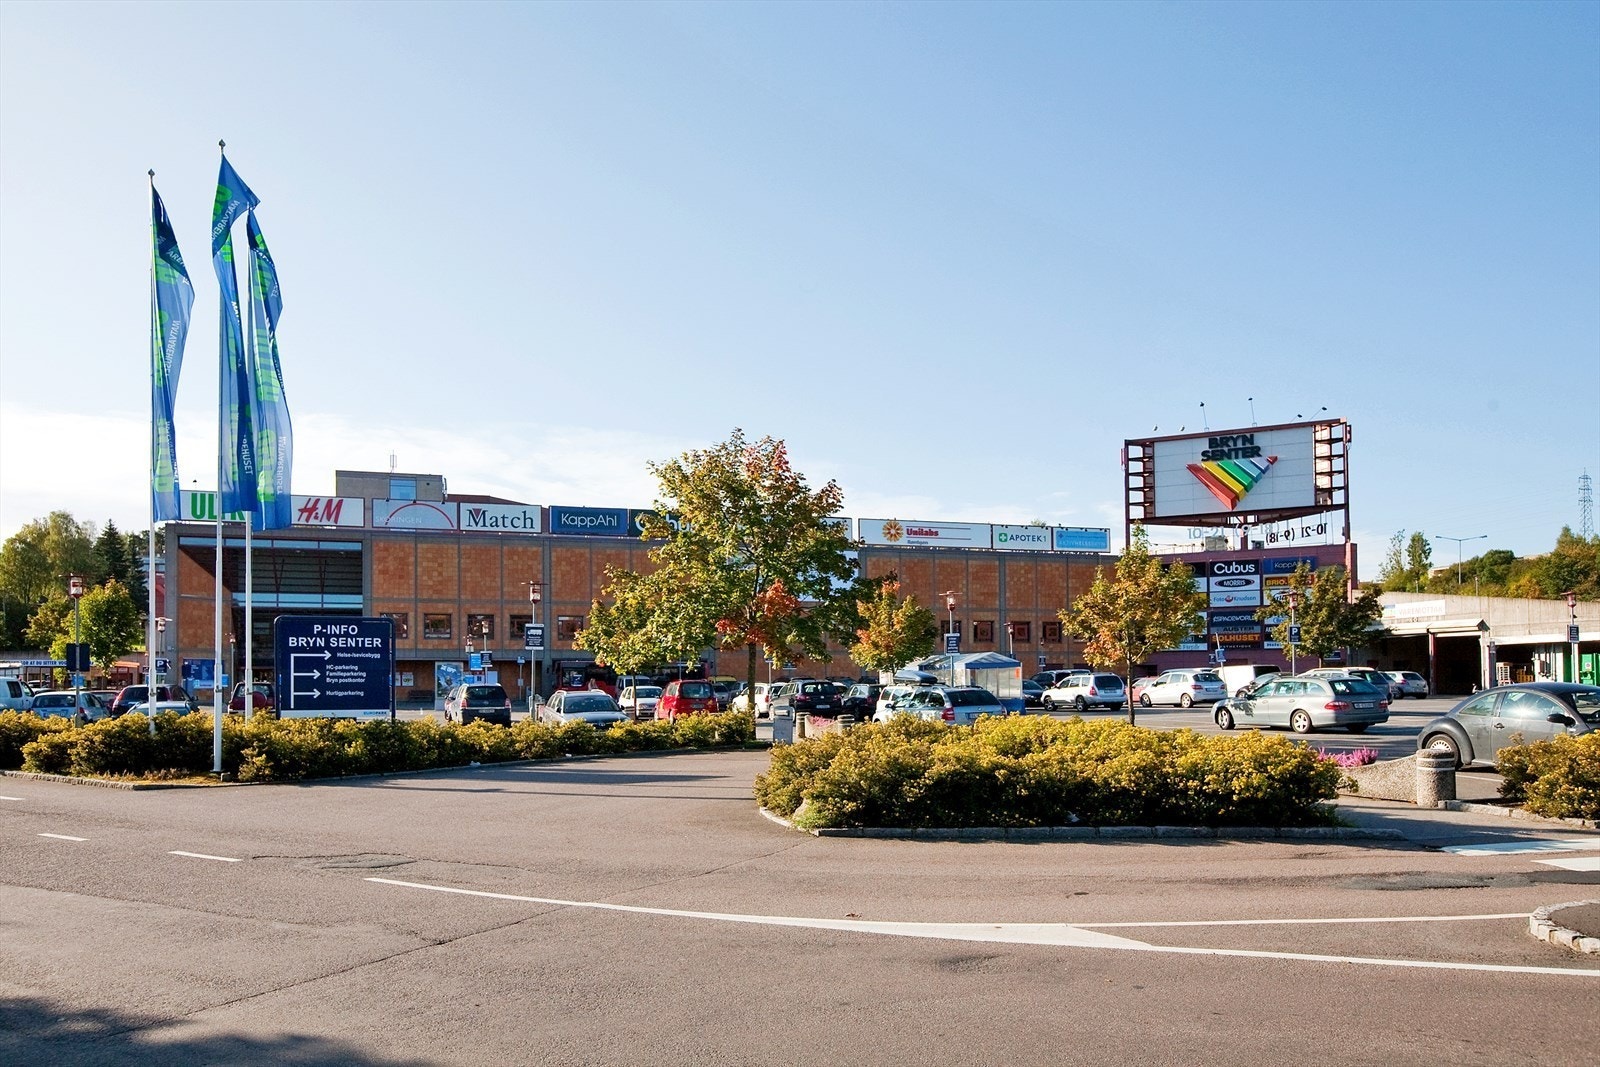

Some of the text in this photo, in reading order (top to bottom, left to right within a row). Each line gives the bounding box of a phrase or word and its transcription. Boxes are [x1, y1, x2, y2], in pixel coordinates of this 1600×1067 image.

[1208, 434, 1255, 449] BRYN
[1201, 446, 1263, 461] SENTER
[298, 498, 344, 525] H&M
[466, 508, 535, 530] Match
[561, 513, 617, 528] KappAhl
[906, 528, 939, 537] Unilabs
[1214, 562, 1256, 574] Cubus
[1223, 579, 1246, 587] MORRIS
[313, 625, 359, 635] P-INFO
[1292, 628, 1299, 636] P
[289, 637, 382, 648] BRYN SENTER
[1212, 634, 1260, 642] SOLHUSET
[157, 660, 165, 668] P
